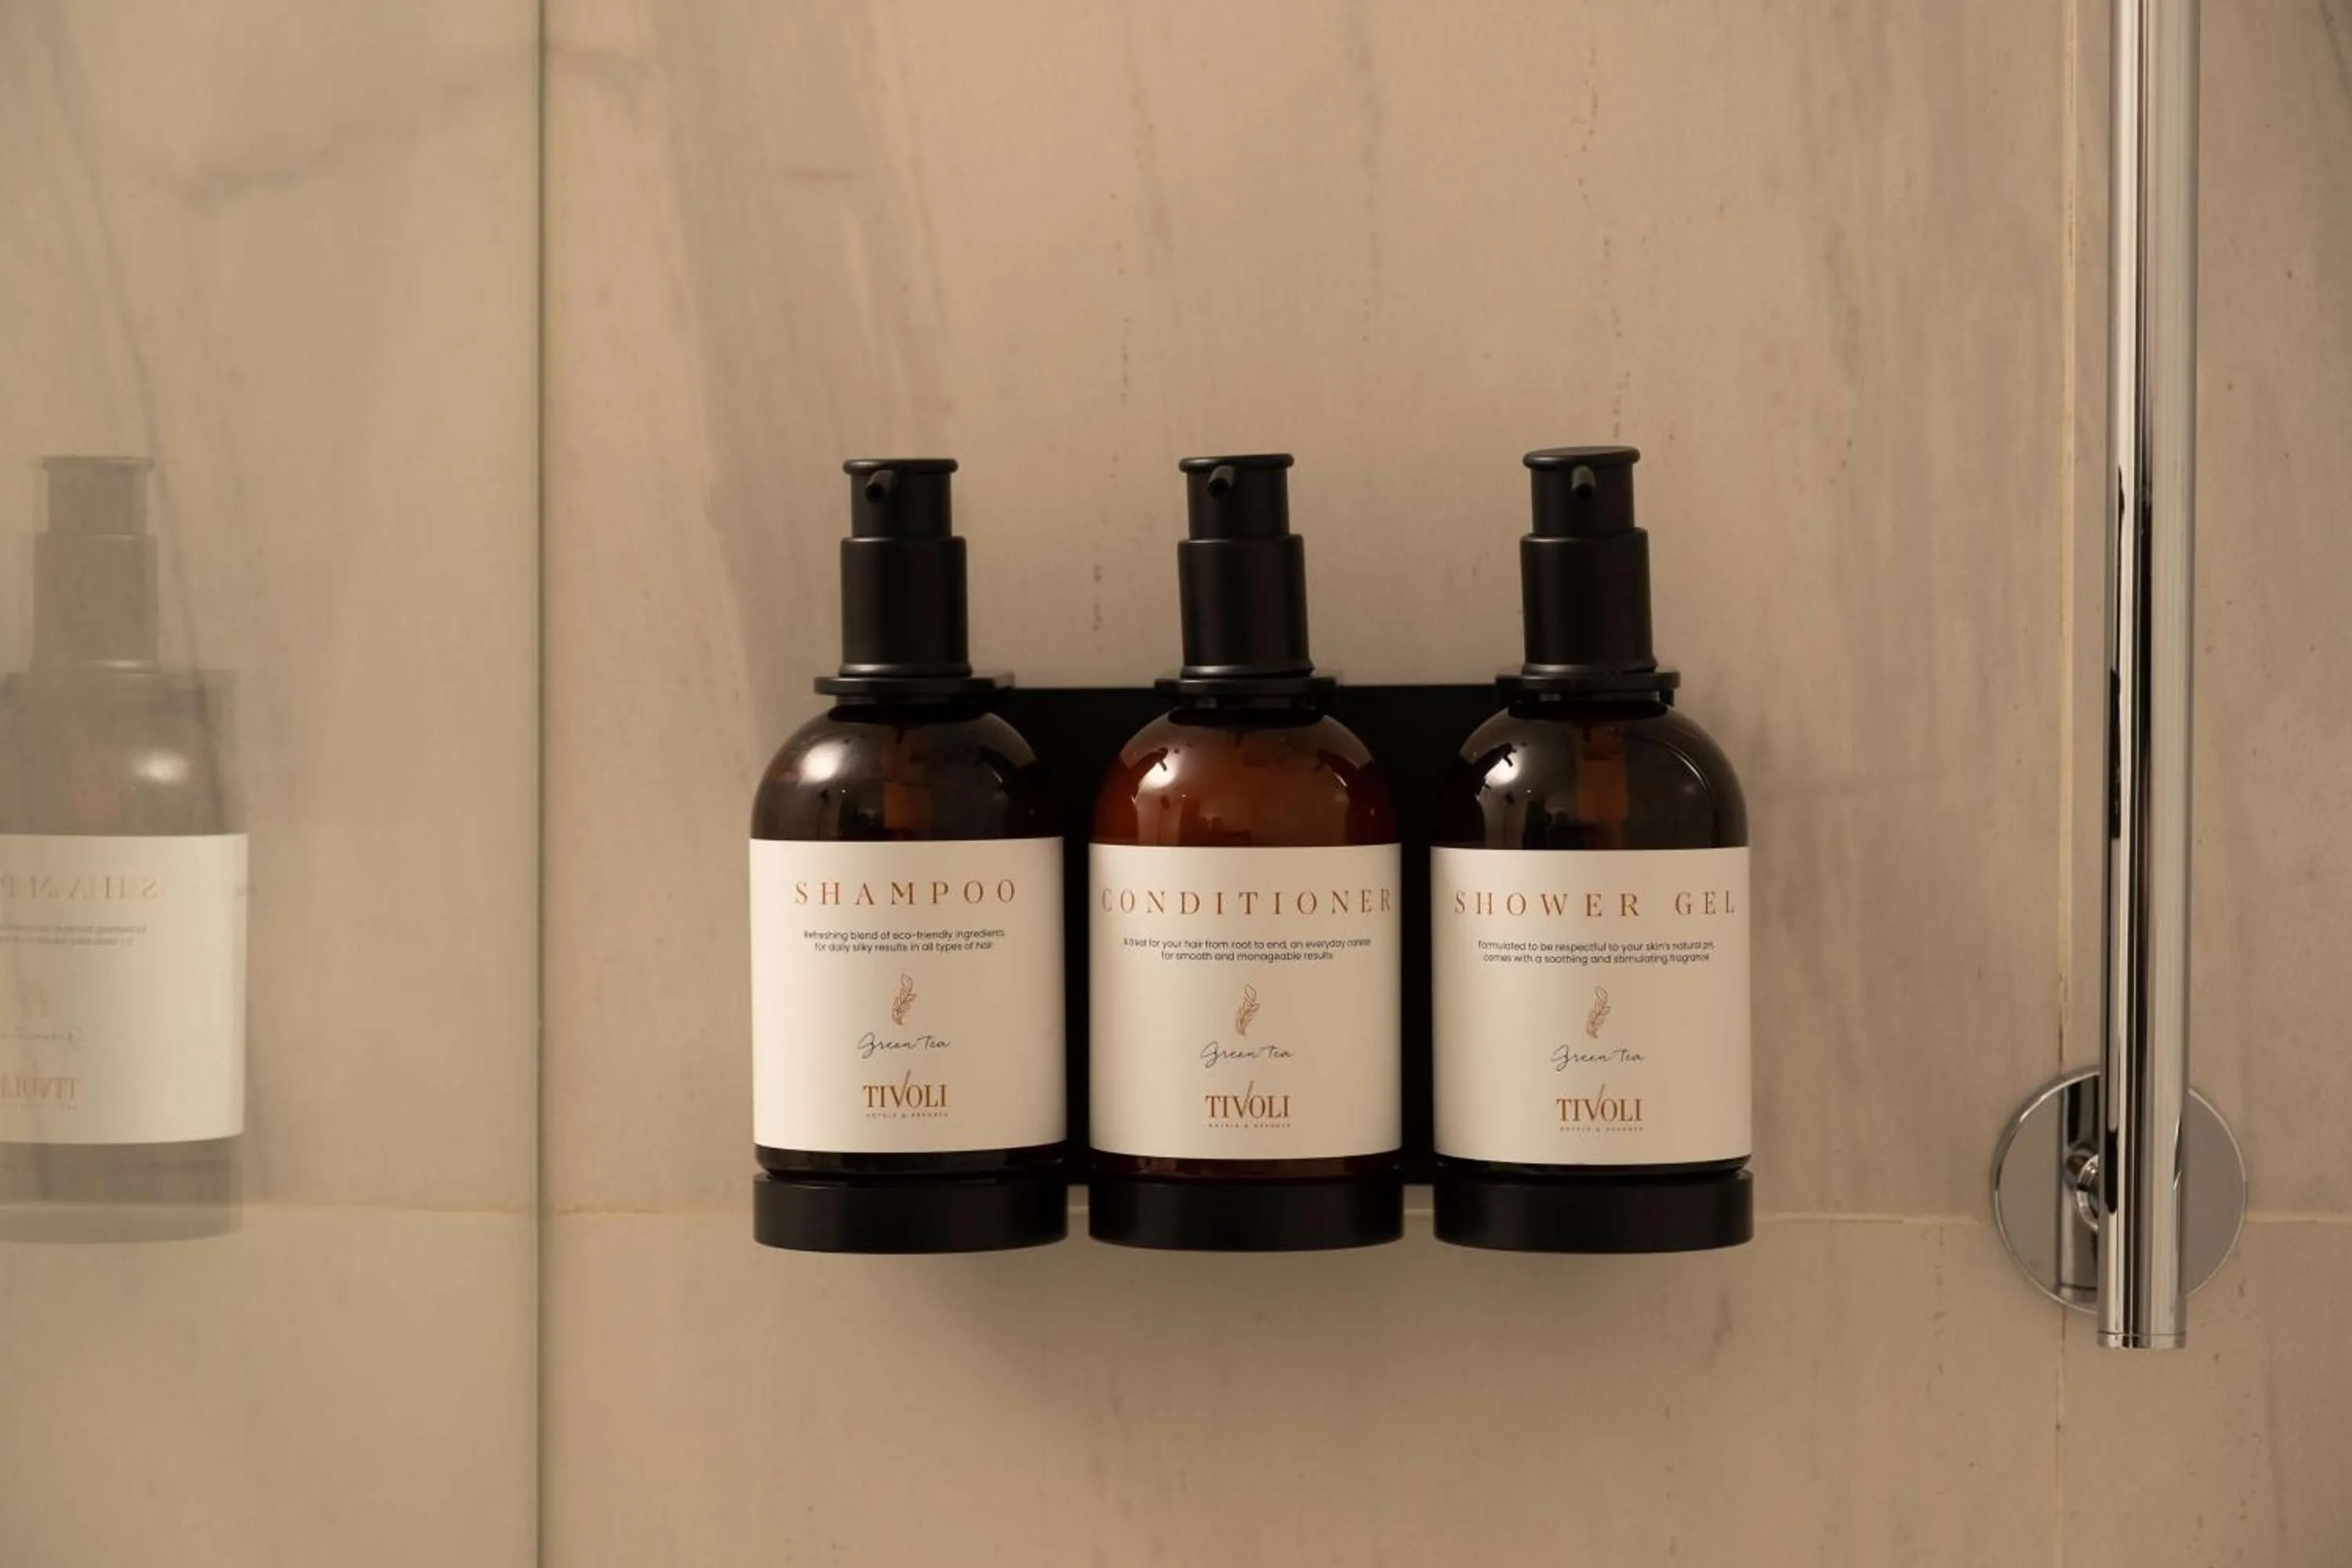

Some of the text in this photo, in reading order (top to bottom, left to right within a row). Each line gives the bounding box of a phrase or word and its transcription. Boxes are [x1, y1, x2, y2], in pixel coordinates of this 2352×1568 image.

[794, 879, 1017, 906] SHAMPOO
[1102, 887, 1392, 916] CONDITIONER
[1454, 890, 1736, 916] SHOWER GEL
[815, 942, 826, 951] for
[852, 942, 873, 953] silky
[875, 942, 909, 951] results
[910, 942, 920, 951] in
[921, 942, 934, 951] all
[936, 942, 962, 953] types
[964, 941, 974, 950] of
[850, 931, 878, 940] blend
[880, 931, 890, 940] of
[892, 930, 953, 941] eco-friendly
[1149, 938, 1160, 947] for
[1161, 940, 1182, 950] your
[1185, 940, 1203, 949] hair
[1205, 939, 1229, 949] from
[1231, 940, 1253, 949] root
[1254, 940, 1265, 949] to
[1305, 940, 1346, 950] everyday
[1528, 942, 1538, 951] to
[1541, 942, 1553, 951] be
[1555, 942, 1606, 953] respectful
[1608, 942, 1619, 951] to
[1621, 943, 1642, 953] your
[1646, 941, 1671, 951] skin's
[1161, 951, 1174, 960] for
[1175, 951, 1213, 960] smooth
[1214, 951, 1235, 960] and
[1236, 951, 1302, 964] manageable
[1514, 954, 1533, 963] with
[1544, 954, 1588, 965] soothing
[1590, 955, 1611, 964] and
[1613, 954, 1668, 965] stimulating
[857, 1031, 952, 1059] Green Tea
[1200, 1040, 1295, 1069] Green Tea
[1551, 1044, 1646, 1073] Green Tea
[862, 1068, 949, 1109] TIVOLI
[1205, 1080, 1291, 1119] TIVOLI
[1556, 1083, 1643, 1122] TIVOLI
